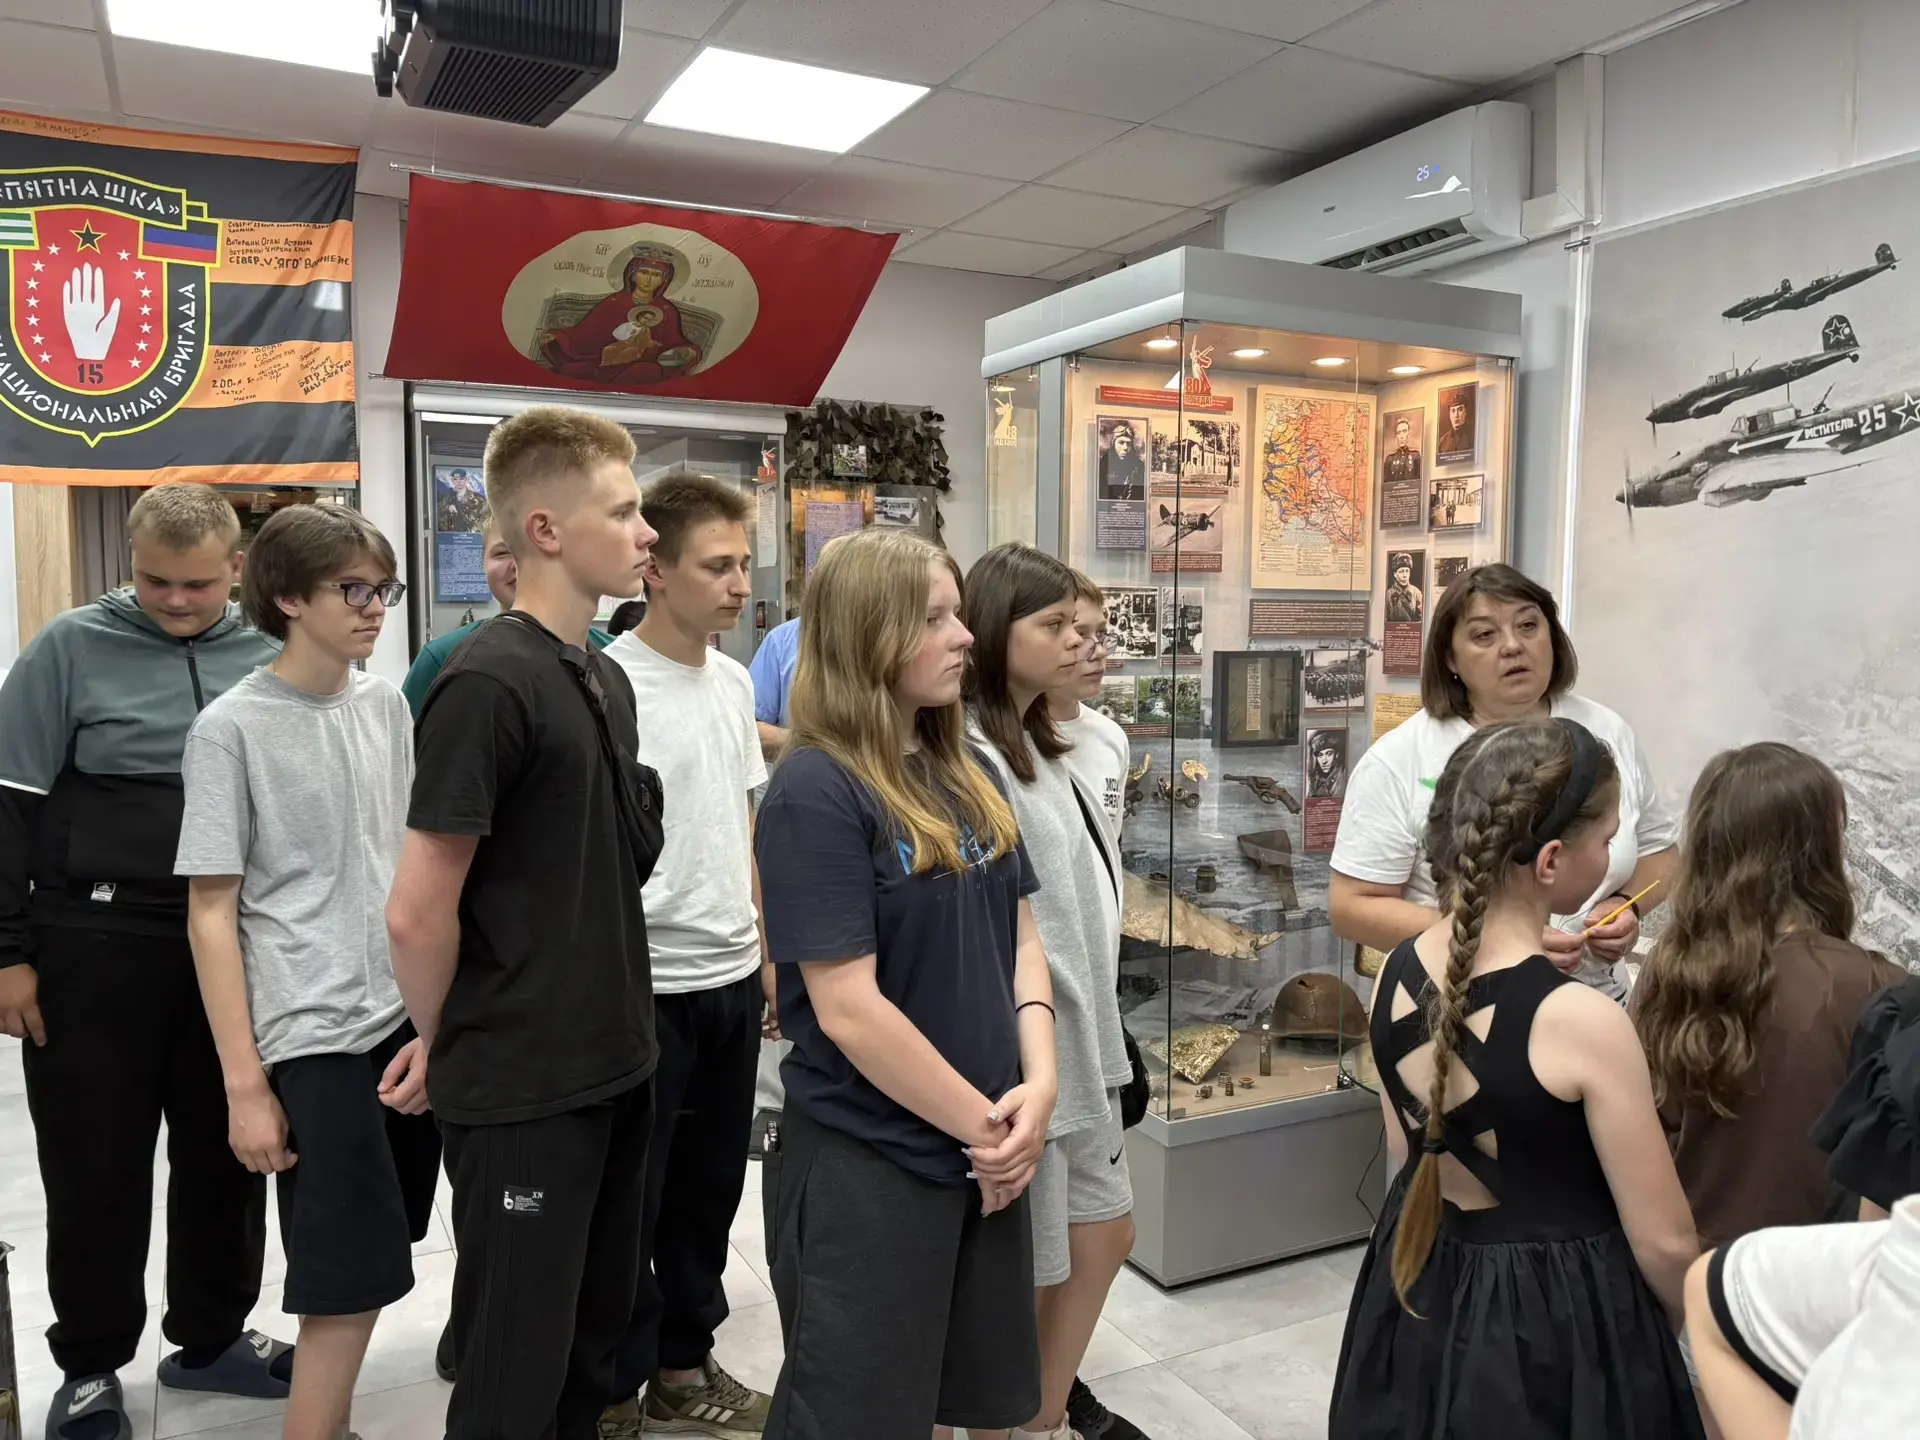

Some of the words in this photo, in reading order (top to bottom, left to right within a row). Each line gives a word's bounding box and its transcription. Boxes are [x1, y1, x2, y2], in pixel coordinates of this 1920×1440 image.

[1416, 164, 1429, 181] 25
[0, 177, 180, 215] ПЯТНАШКА»
[163, 283, 195, 386] БРИГАДА
[78, 363, 104, 385] 15
[74, 1379, 108, 1400] NIKE
